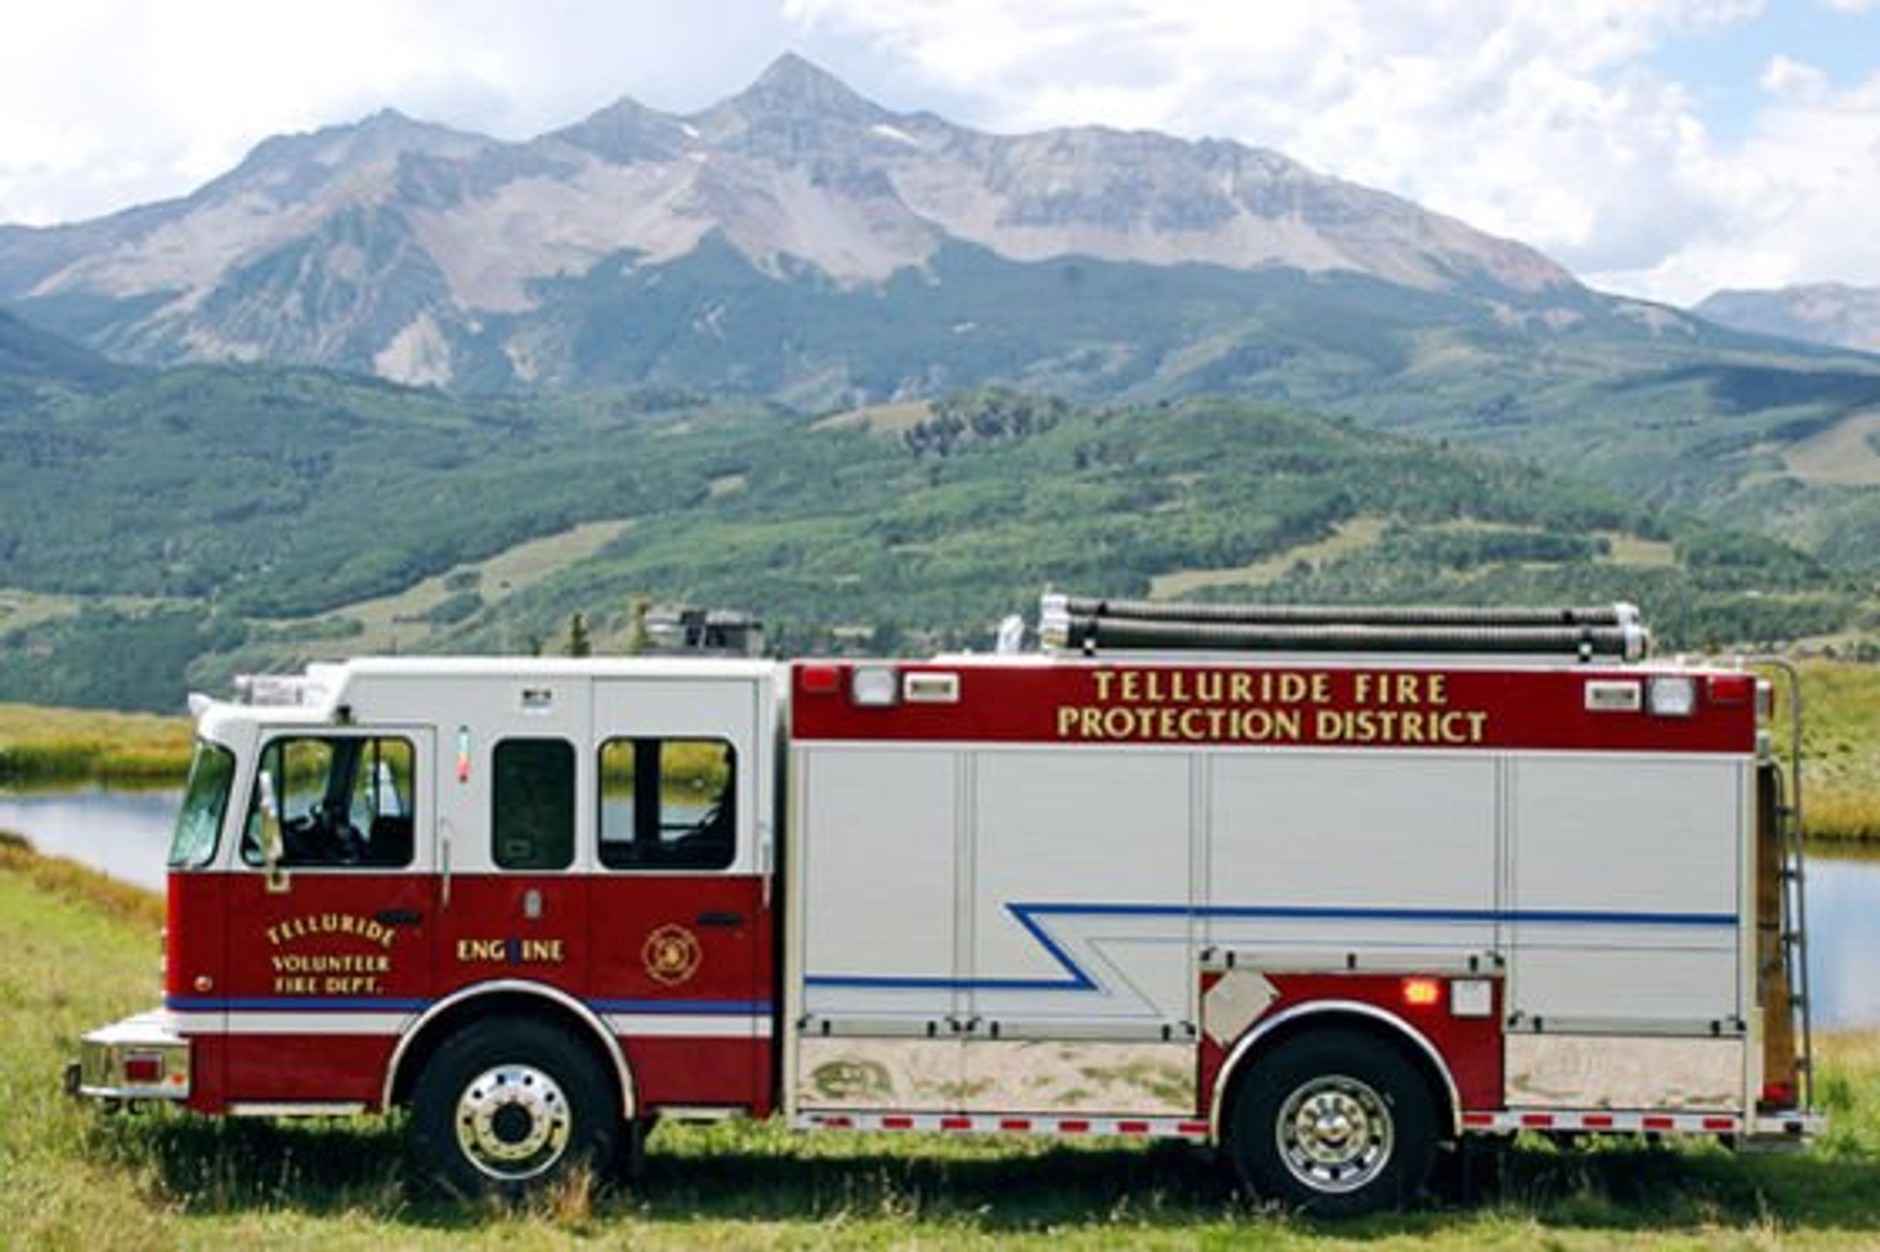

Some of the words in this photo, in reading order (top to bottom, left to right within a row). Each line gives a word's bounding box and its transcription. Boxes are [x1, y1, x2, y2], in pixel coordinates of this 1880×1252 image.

[1093, 671, 1331, 702] TELLURIDE
[1355, 673, 1448, 704] FIRE
[1057, 707, 1300, 740] PROTECTION
[1315, 710, 1488, 743] DISTRICT
[267, 913, 396, 948] TELLURIDE
[271, 955, 391, 972] VOLUNTEER
[274, 976, 318, 994] FIRE
[325, 976, 384, 995] DEPT.
